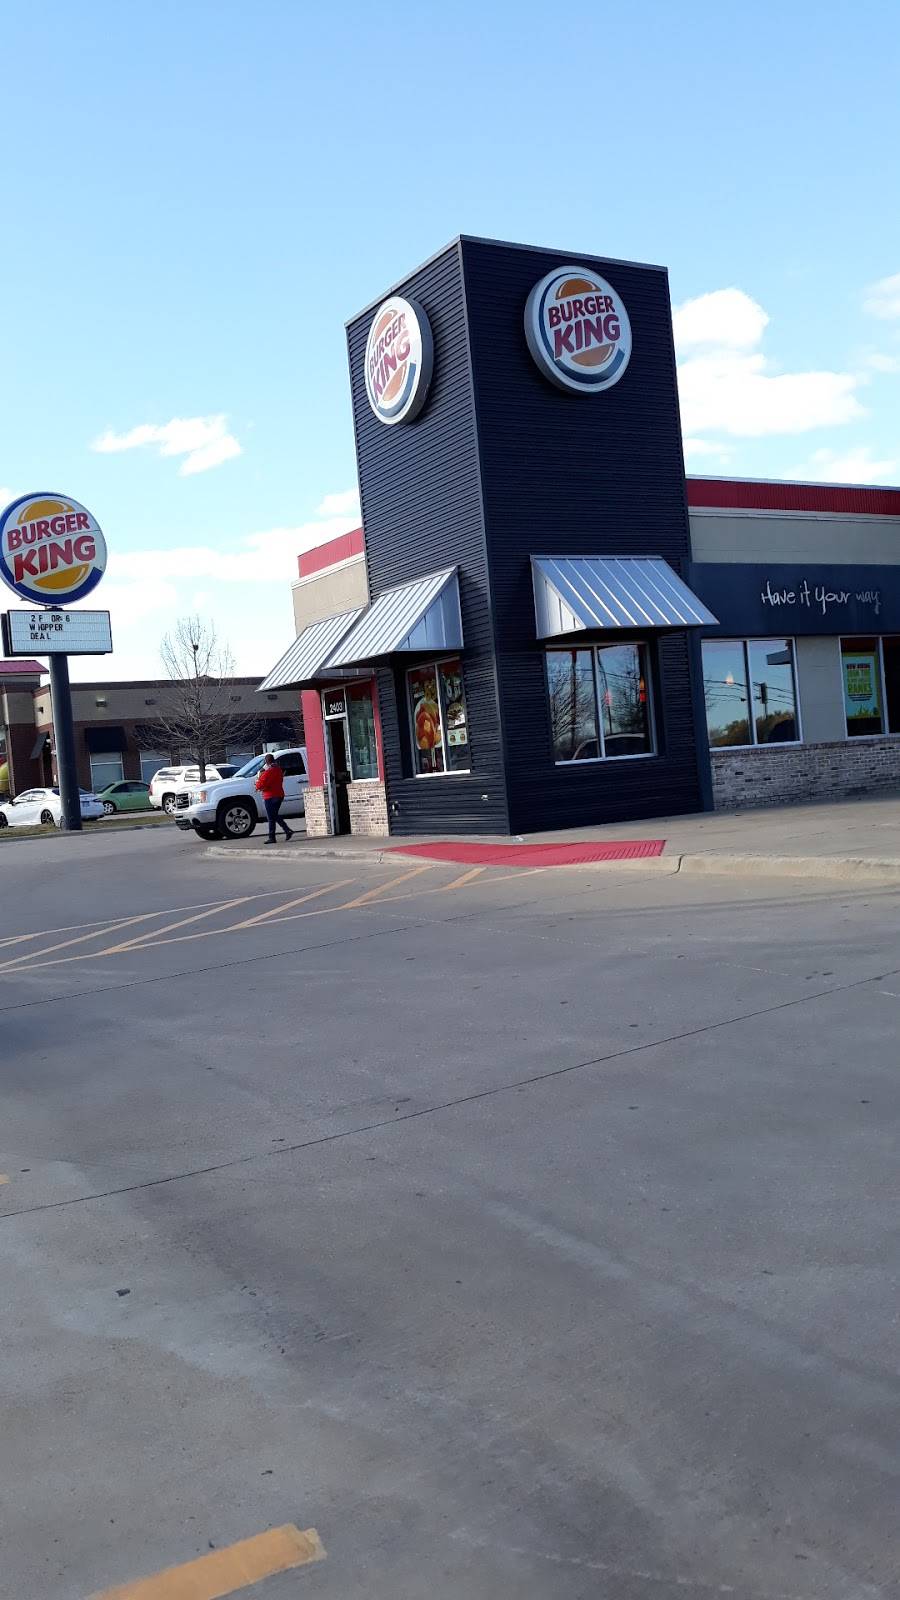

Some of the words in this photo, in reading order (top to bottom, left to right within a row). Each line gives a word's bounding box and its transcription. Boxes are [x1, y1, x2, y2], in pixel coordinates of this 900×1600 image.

[548, 295, 615, 328] BURGER
[369, 312, 407, 378] BURGER
[553, 314, 621, 359] KING
[371, 330, 411, 403] KING
[7, 512, 91, 551] BURGER
[14, 535, 96, 582] KING
[761, 580, 796, 606] Have
[800, 580, 811, 607] it
[30, 632, 52, 640] DEAL
[31, 614, 36, 622] 2
[329, 701, 343, 713] 2403
